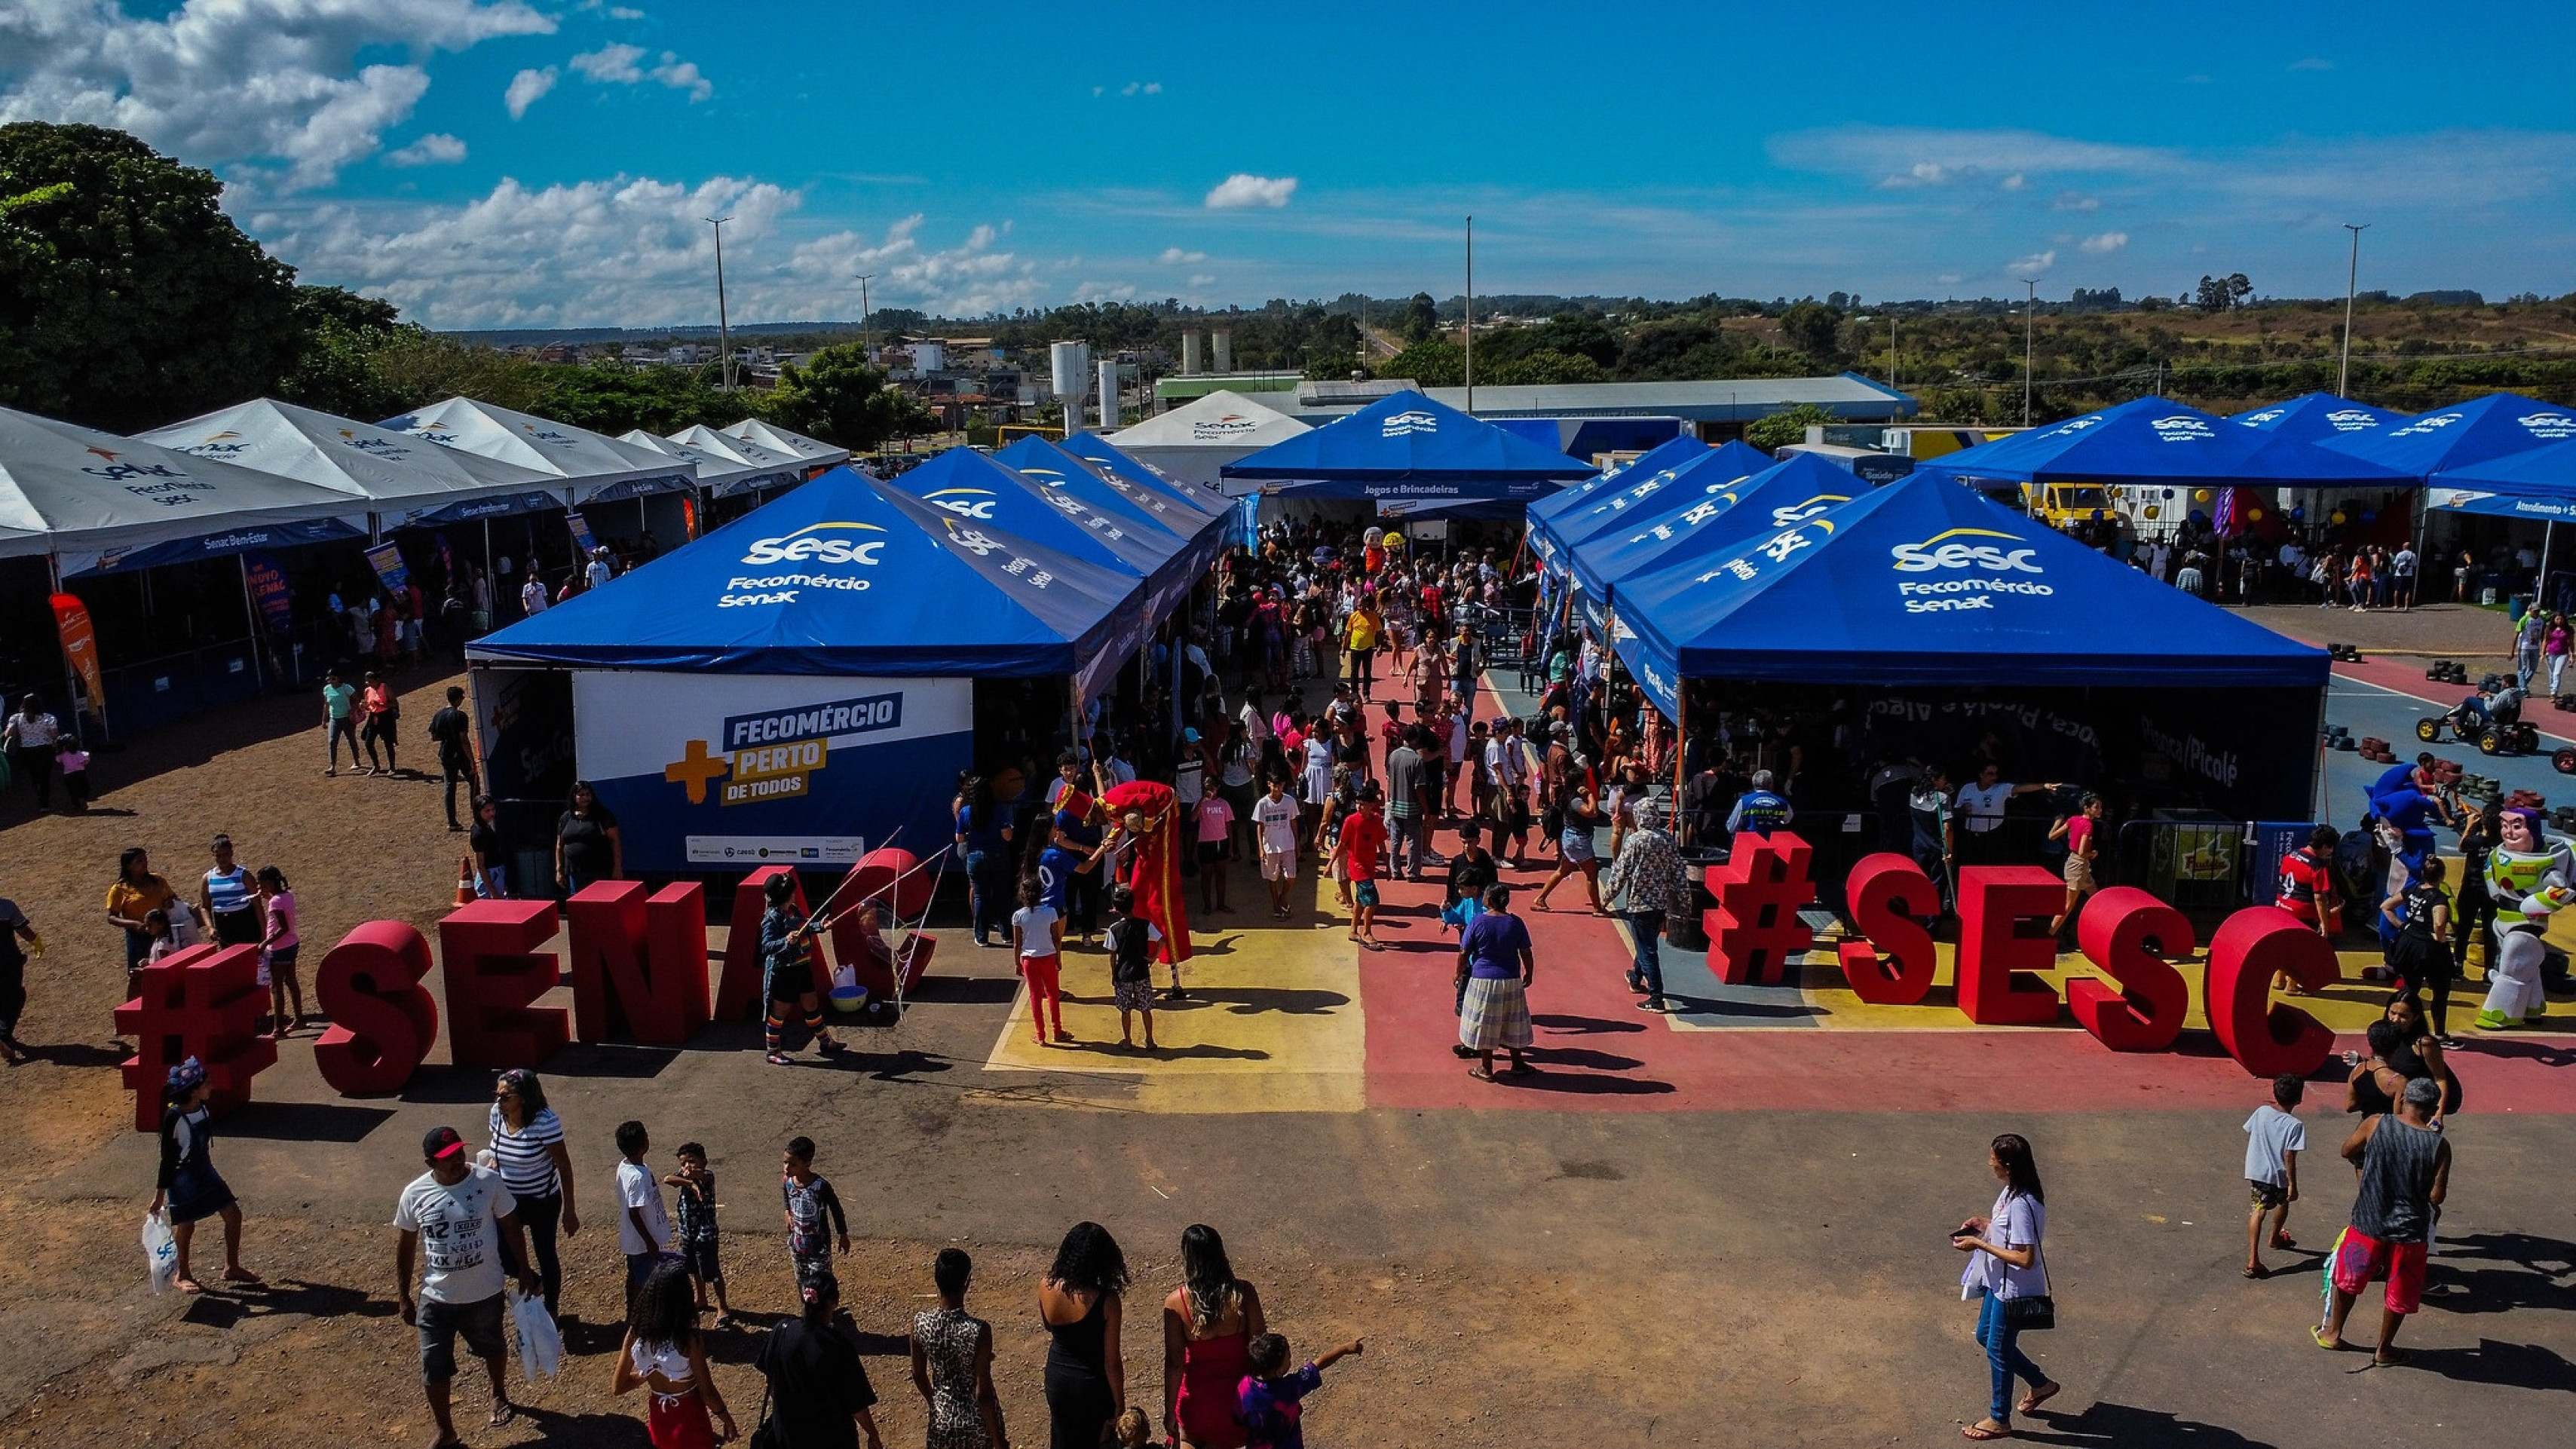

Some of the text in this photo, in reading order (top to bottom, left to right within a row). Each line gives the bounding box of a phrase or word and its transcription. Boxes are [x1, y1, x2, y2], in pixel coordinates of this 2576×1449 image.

[1364, 485, 1391, 496] Jogos
[1401, 485, 1460, 495] Brincadeiras
[740, 537, 885, 565] Sesc
[1891, 543, 2044, 572] Sesc
[725, 574, 871, 591] Fecomércio
[1898, 578, 2054, 596] Fecomércio
[717, 591, 800, 608] Senac
[1904, 595, 1994, 613] Senac
[733, 700, 894, 746] FECOMÉRCIO
[740, 743, 820, 775] PERTO
[727, 777, 802, 801] DE TODOS
[1702, 831, 2341, 1079] #SESC
[114, 847, 937, 1132] #SENAC
